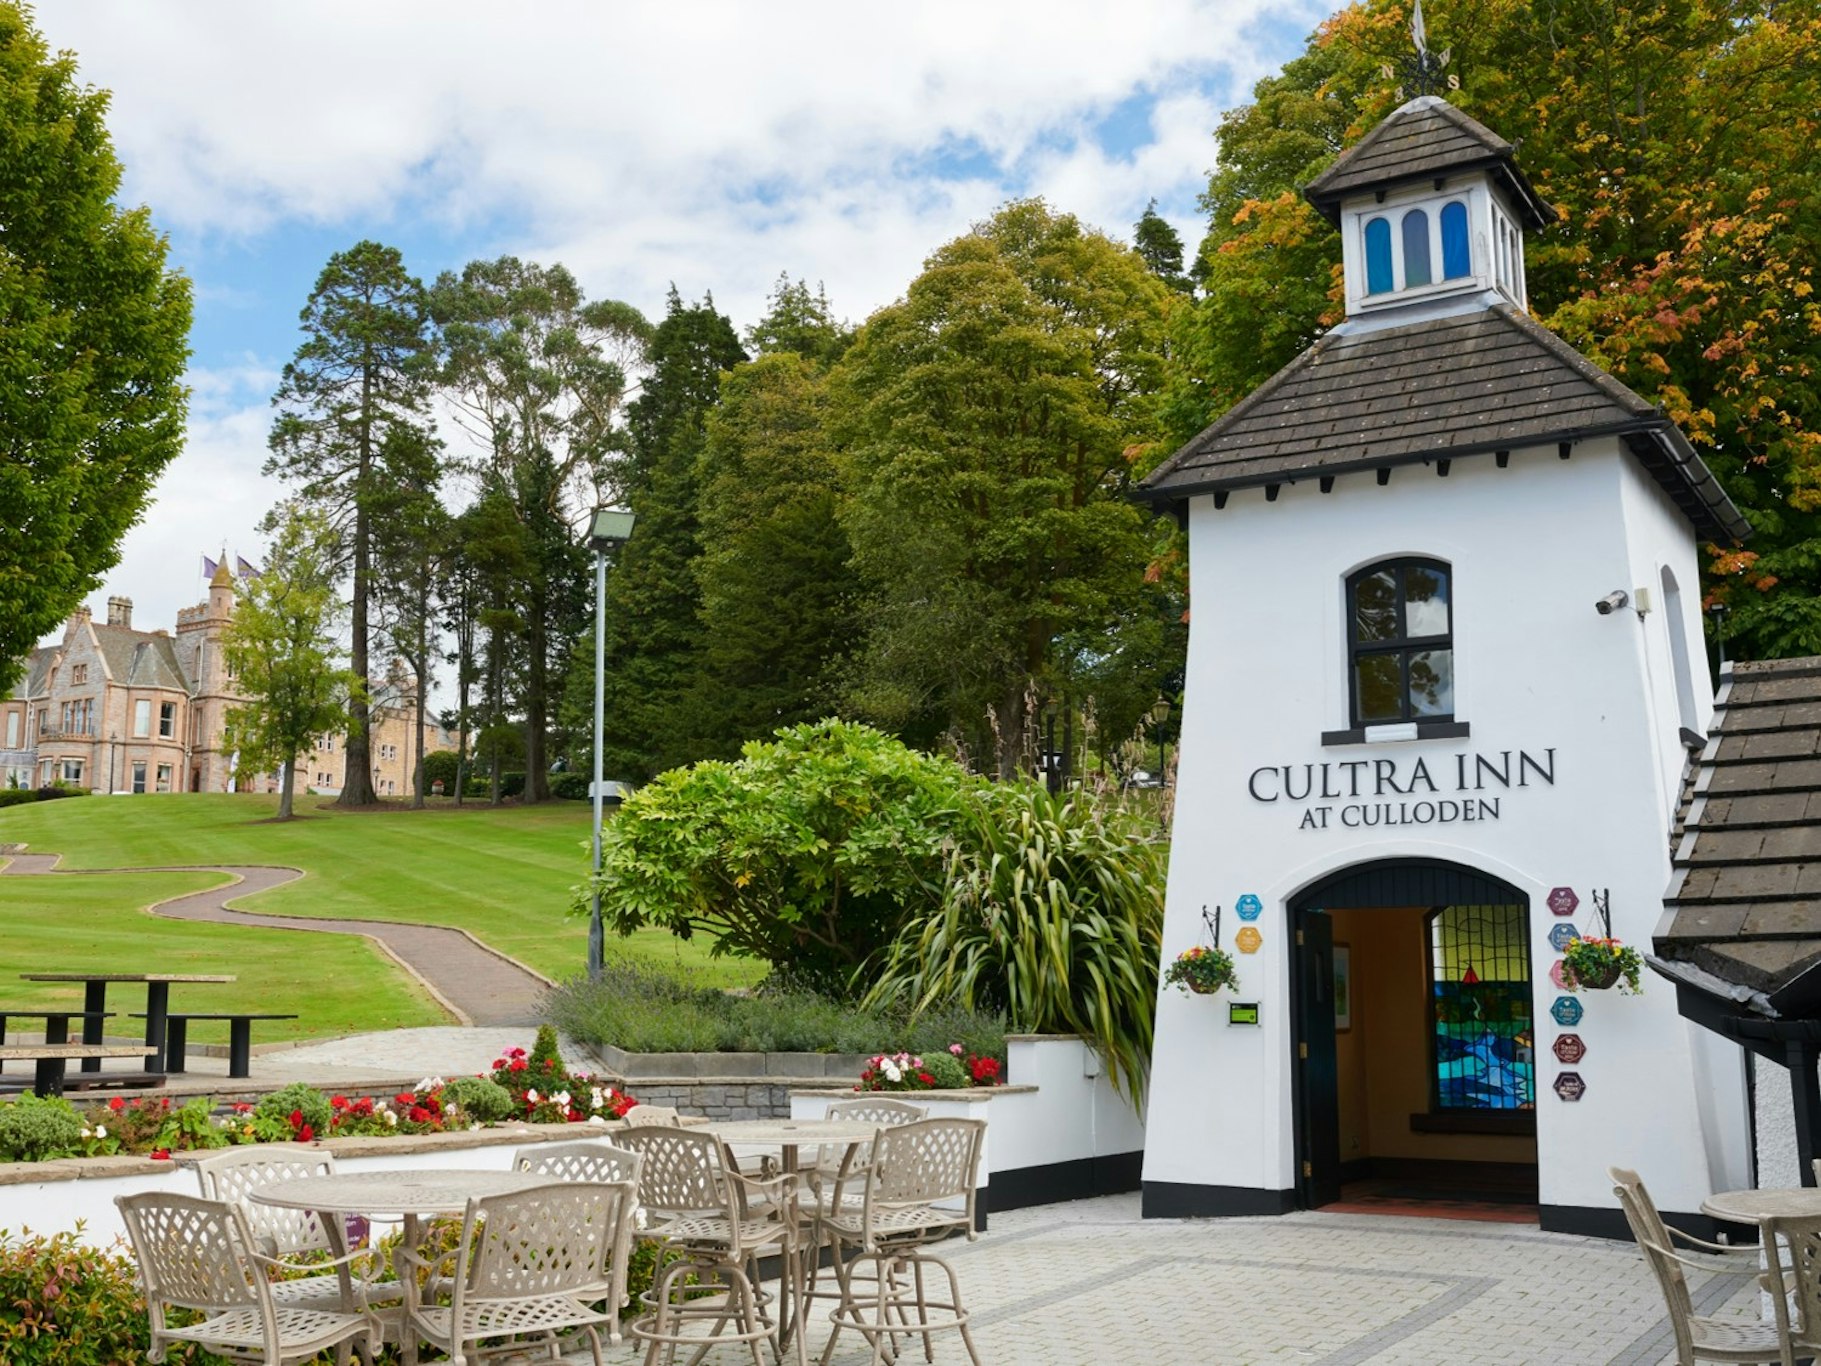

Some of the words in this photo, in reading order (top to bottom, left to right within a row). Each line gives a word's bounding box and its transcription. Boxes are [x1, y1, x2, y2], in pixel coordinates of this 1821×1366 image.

[1381, 64, 1394, 79] N
[1447, 74, 1460, 90] S
[1248, 756, 1439, 802] CULTRA
[1455, 748, 1556, 790] INN
[1299, 806, 1332, 829] AT
[1340, 798, 1500, 828] CULLODEN
